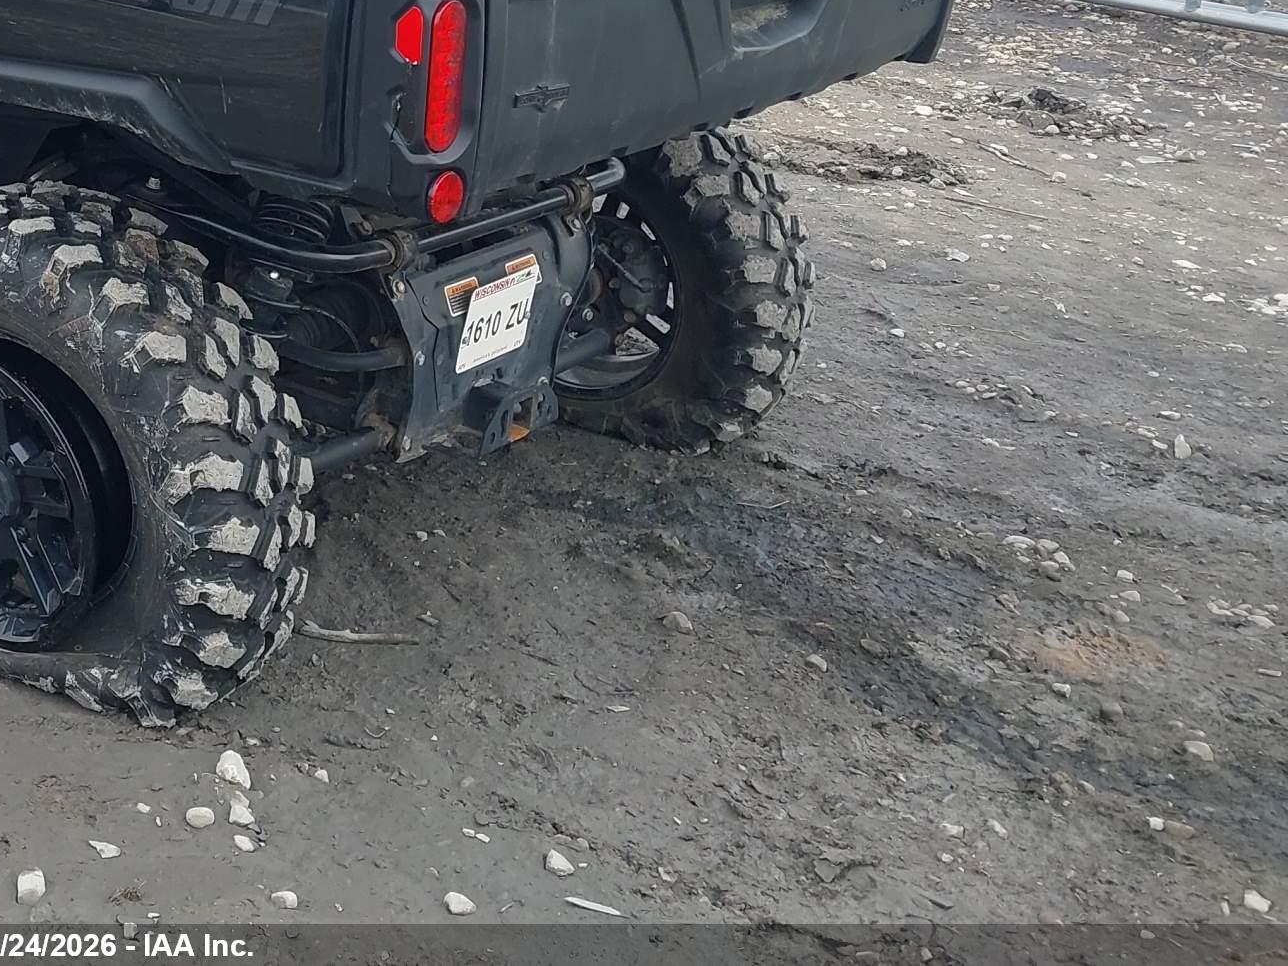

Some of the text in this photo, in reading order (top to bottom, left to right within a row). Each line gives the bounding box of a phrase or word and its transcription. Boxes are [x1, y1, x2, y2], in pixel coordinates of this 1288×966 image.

[474, 278, 511, 298] WISCONSIN
[466, 310, 502, 346] 1610
[505, 298, 529, 329] ZU
